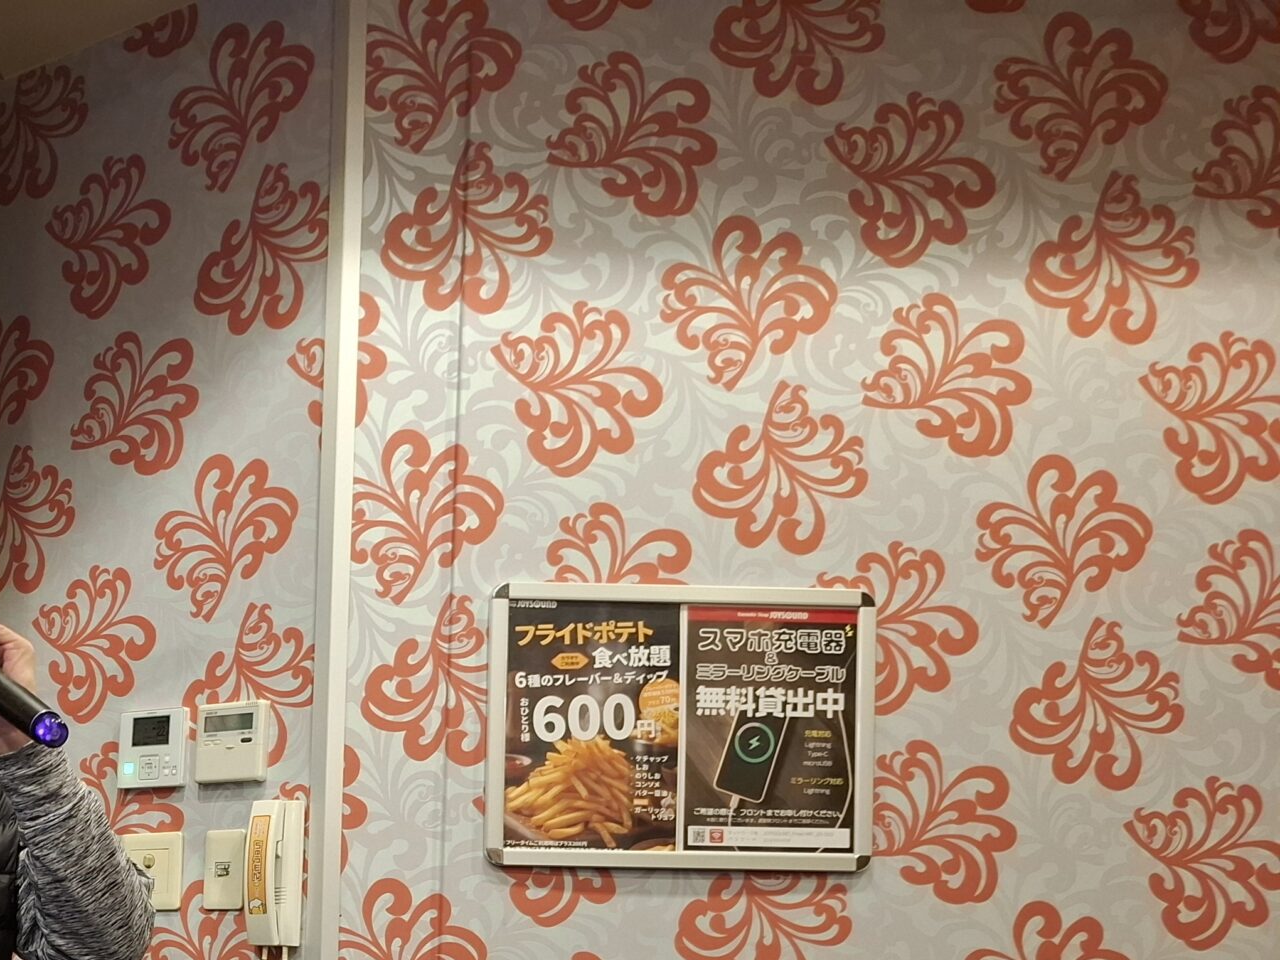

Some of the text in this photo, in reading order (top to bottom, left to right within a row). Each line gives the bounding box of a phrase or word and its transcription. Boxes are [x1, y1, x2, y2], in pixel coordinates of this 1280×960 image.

[769, 611, 809, 620] JOYSOUND
[515, 620, 654, 646] フライドポテト
[698, 628, 846, 654] スマホ充電器
[592, 645, 671, 669] 食べ放題
[764, 651, 779, 665] &
[696, 663, 847, 683] ミラーリングケーブル
[696, 685, 845, 719] 無料貸出中
[519, 697, 531, 743] おひとり様
